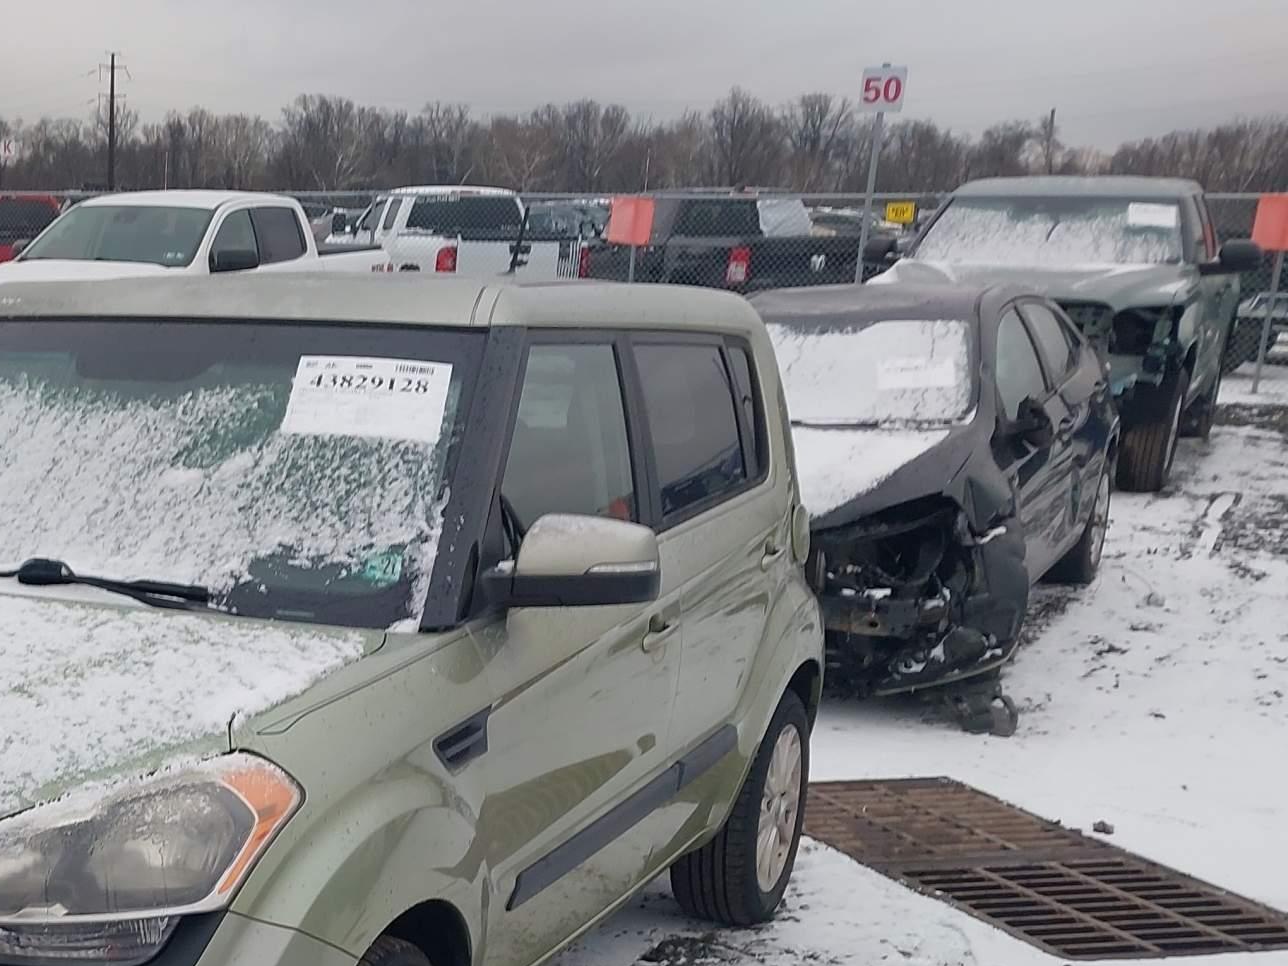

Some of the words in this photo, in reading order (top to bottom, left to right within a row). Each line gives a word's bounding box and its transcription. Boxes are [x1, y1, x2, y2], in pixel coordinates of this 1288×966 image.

[863, 76, 902, 103] 50
[3, 140, 12, 154] K
[310, 373, 430, 394] 43829128
